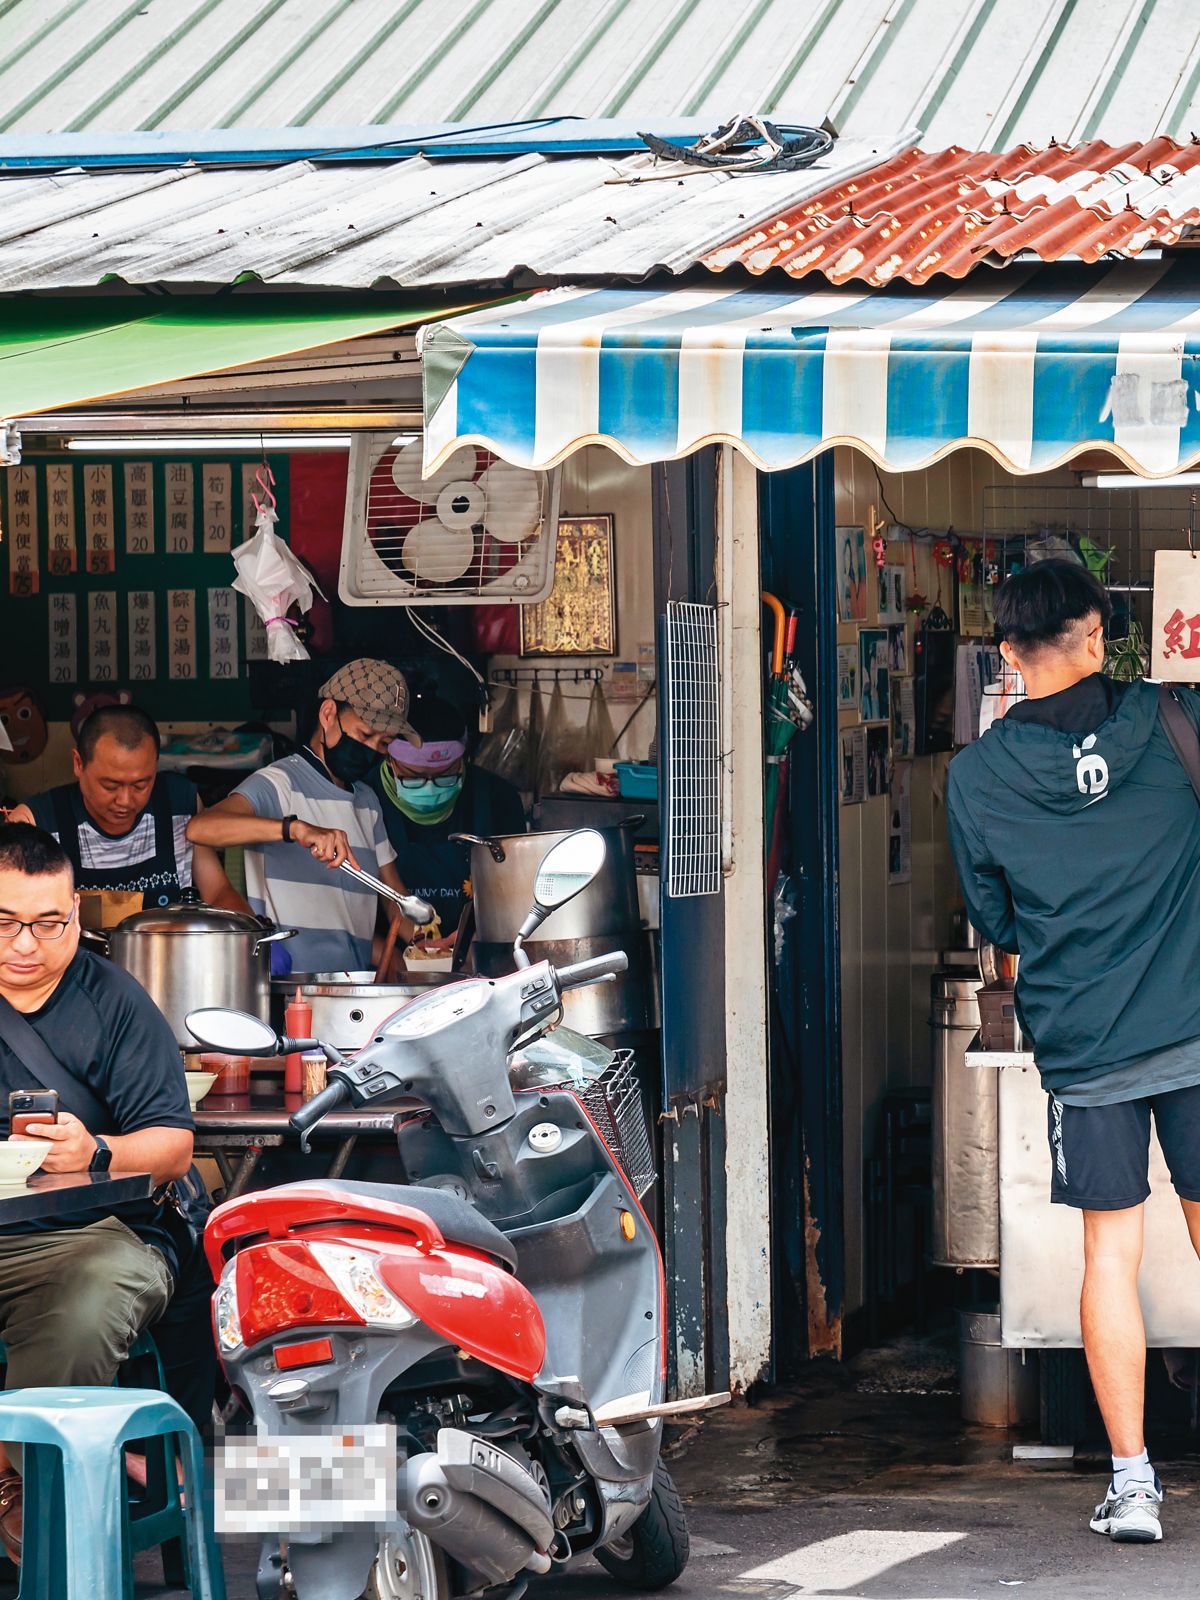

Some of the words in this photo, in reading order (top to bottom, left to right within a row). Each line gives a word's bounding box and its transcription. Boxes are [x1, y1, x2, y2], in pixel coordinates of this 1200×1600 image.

[170, 465, 187, 530] 油豆腐
[208, 525, 226, 540] 20
[132, 537, 149, 552] 20
[172, 537, 188, 551] 10
[53, 595, 71, 659] 味噌湯
[93, 593, 111, 658] 魚丸湯
[172, 591, 191, 656] 綜合湯
[212, 589, 232, 655] 竹筍湯
[54, 667, 71, 682] 20
[95, 665, 111, 680] 20
[135, 664, 151, 679] 20
[174, 663, 191, 678] 30
[215, 661, 232, 677] 20
[409, 887, 438, 898] UNNY
[440, 887, 461, 898] DAY
